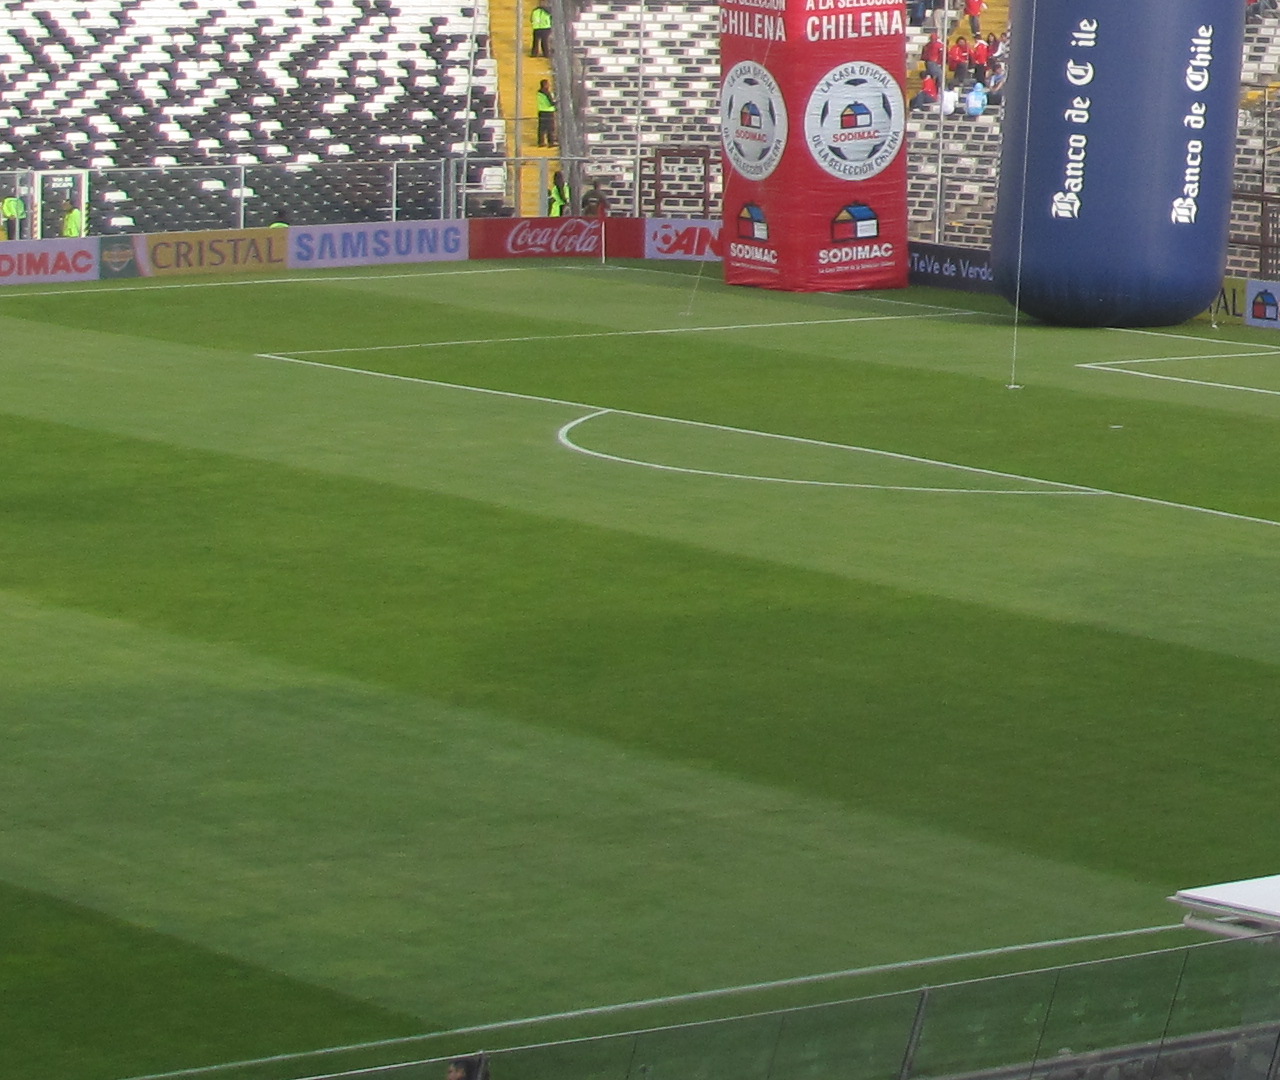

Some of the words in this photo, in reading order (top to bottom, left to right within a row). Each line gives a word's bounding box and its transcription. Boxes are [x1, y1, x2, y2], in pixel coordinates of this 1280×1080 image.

[807, 9, 904, 42] CHILENA
[1066, 18, 1099, 87] Cile
[1185, 23, 1214, 93] Chile
[1064, 95, 1092, 125] de
[1183, 101, 1208, 130] de
[832, 129, 881, 143] SODIMAC
[1051, 133, 1088, 219] Banco
[1171, 139, 1204, 225] Banco
[151, 236, 285, 269] CRISTAL
[295, 225, 462, 261] SAMSUNG
[506, 219, 600, 255] Coca-Cola
[655, 225, 724, 262] AN
[730, 242, 778, 265] SODIMAC
[818, 242, 894, 265] SODIMAC
[0, 250, 93, 276] DIMAC
[942, 257, 957, 277] de
